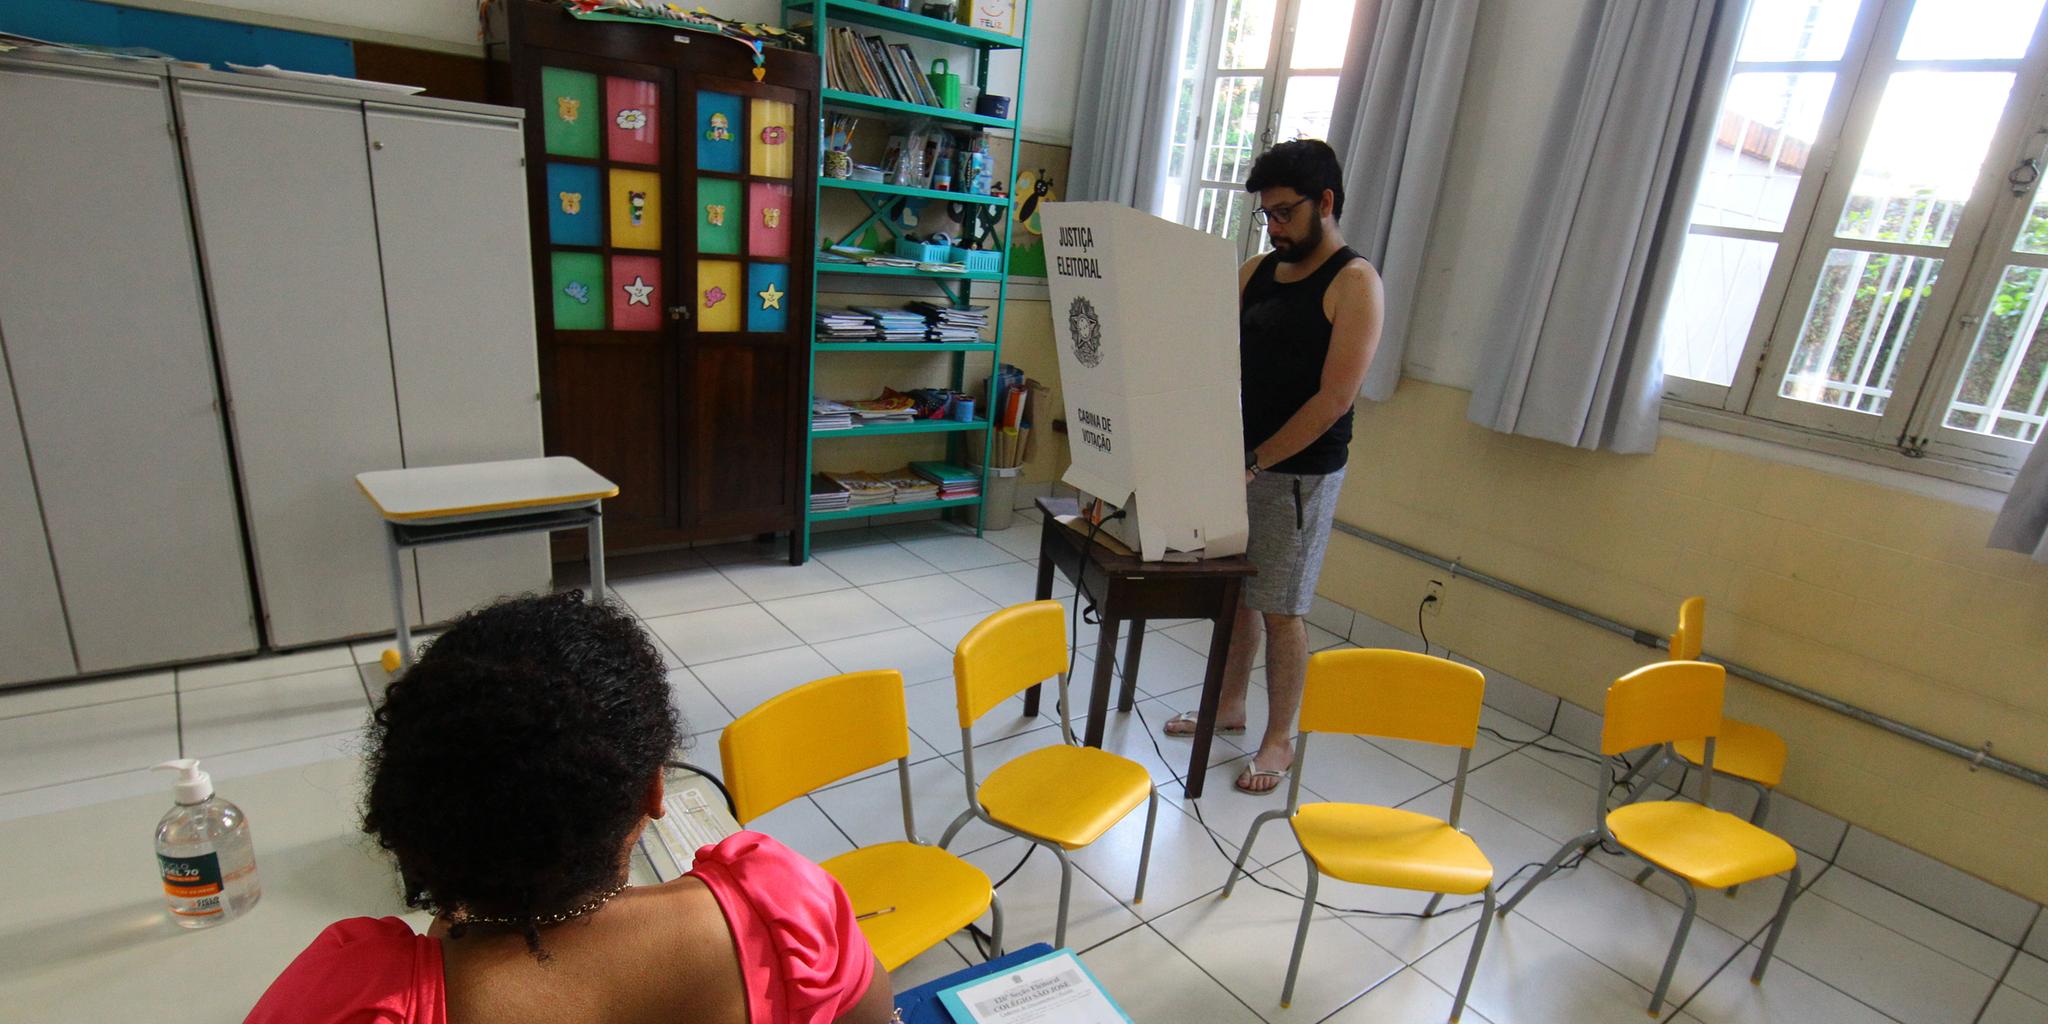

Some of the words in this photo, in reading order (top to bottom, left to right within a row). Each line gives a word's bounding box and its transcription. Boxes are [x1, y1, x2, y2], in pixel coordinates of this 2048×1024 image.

[1059, 227, 1094, 253] JUSTIÇA
[1057, 256, 1102, 279] ELEITORAL
[1078, 408, 1102, 429] CABINA
[1102, 416, 1112, 432] DE
[1082, 428, 1112, 452] VOTAÇÃO
[184, 868, 199, 876] 70
[1030, 976, 1060, 991] Eleitoral
[994, 995, 1032, 1013] COLÉGIO
[1032, 989, 1050, 999] SÃO
